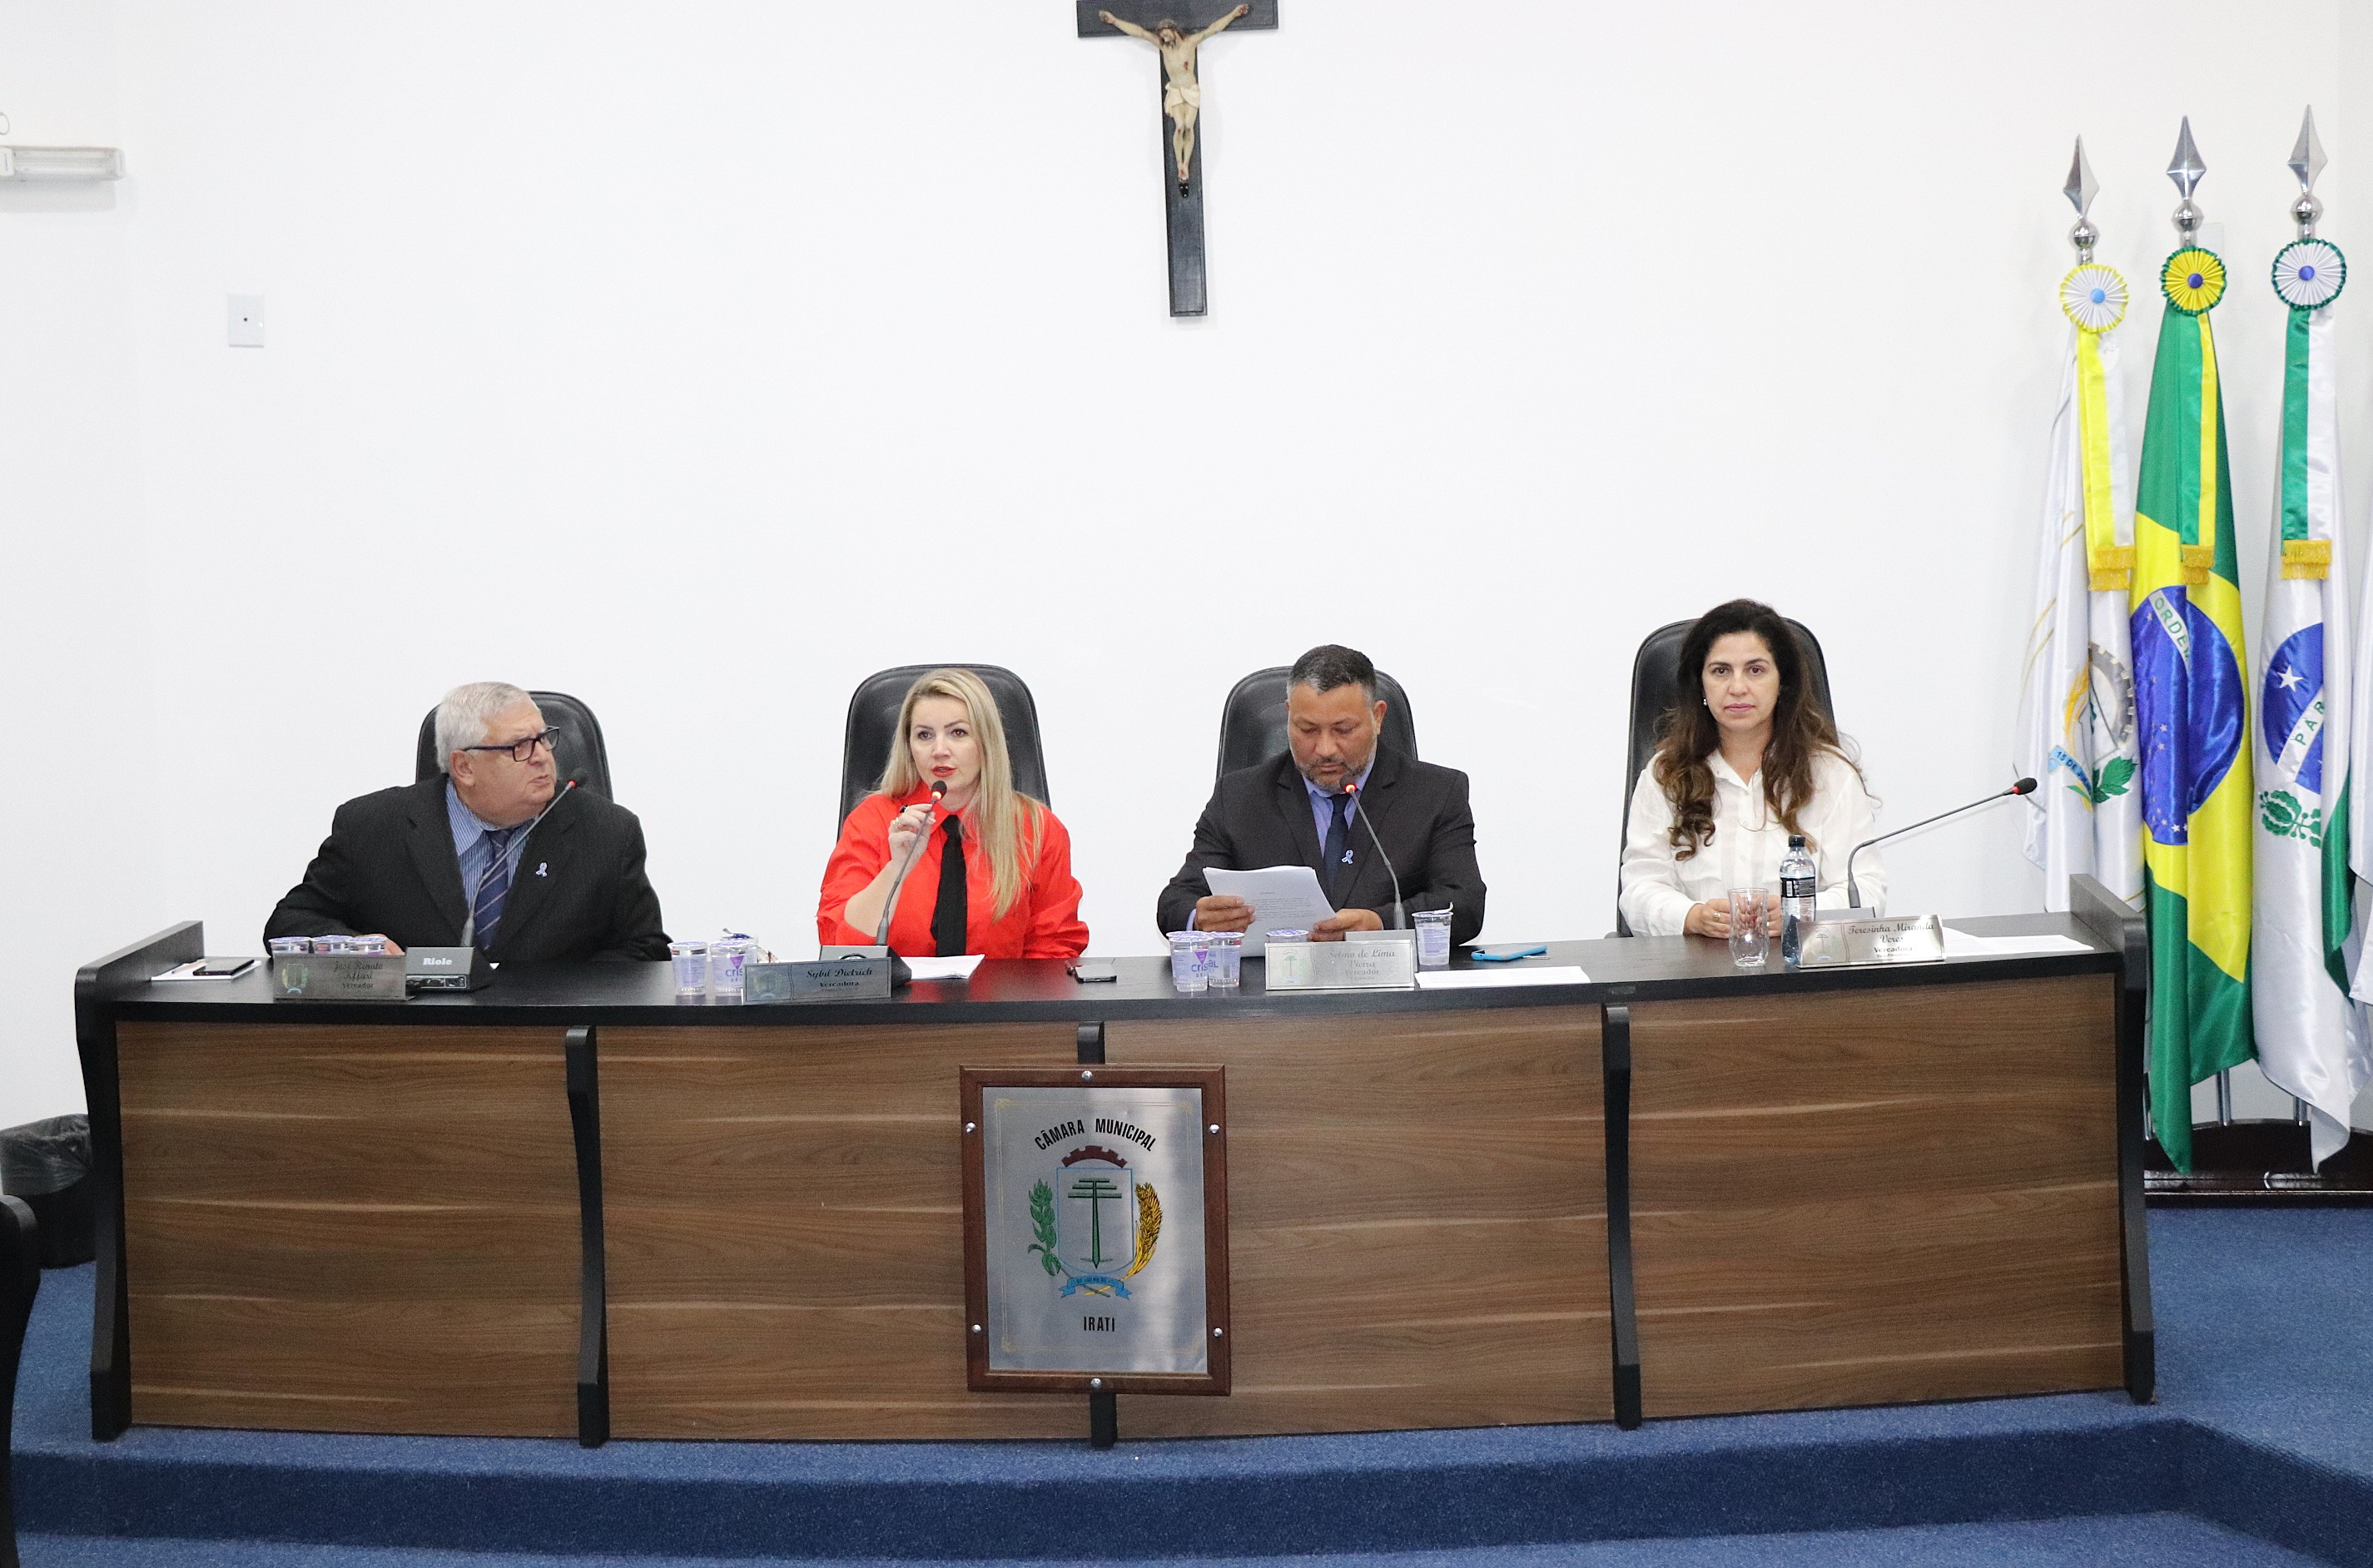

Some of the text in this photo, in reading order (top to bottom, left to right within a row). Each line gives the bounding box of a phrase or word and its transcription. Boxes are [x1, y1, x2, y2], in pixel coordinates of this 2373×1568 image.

[2057, 751, 2067, 762] 15
[1849, 922, 1934, 934] Teresinha Miranda
[1358, 949, 1368, 958] de
[1371, 949, 1395, 958] Lima
[423, 957, 453, 965] Riole
[806, 966, 873, 979] Sybil Dietrich
[1035, 1119, 1156, 1152] CÂMARA MUNICIPAL
[1084, 1317, 1115, 1332] IRATI
